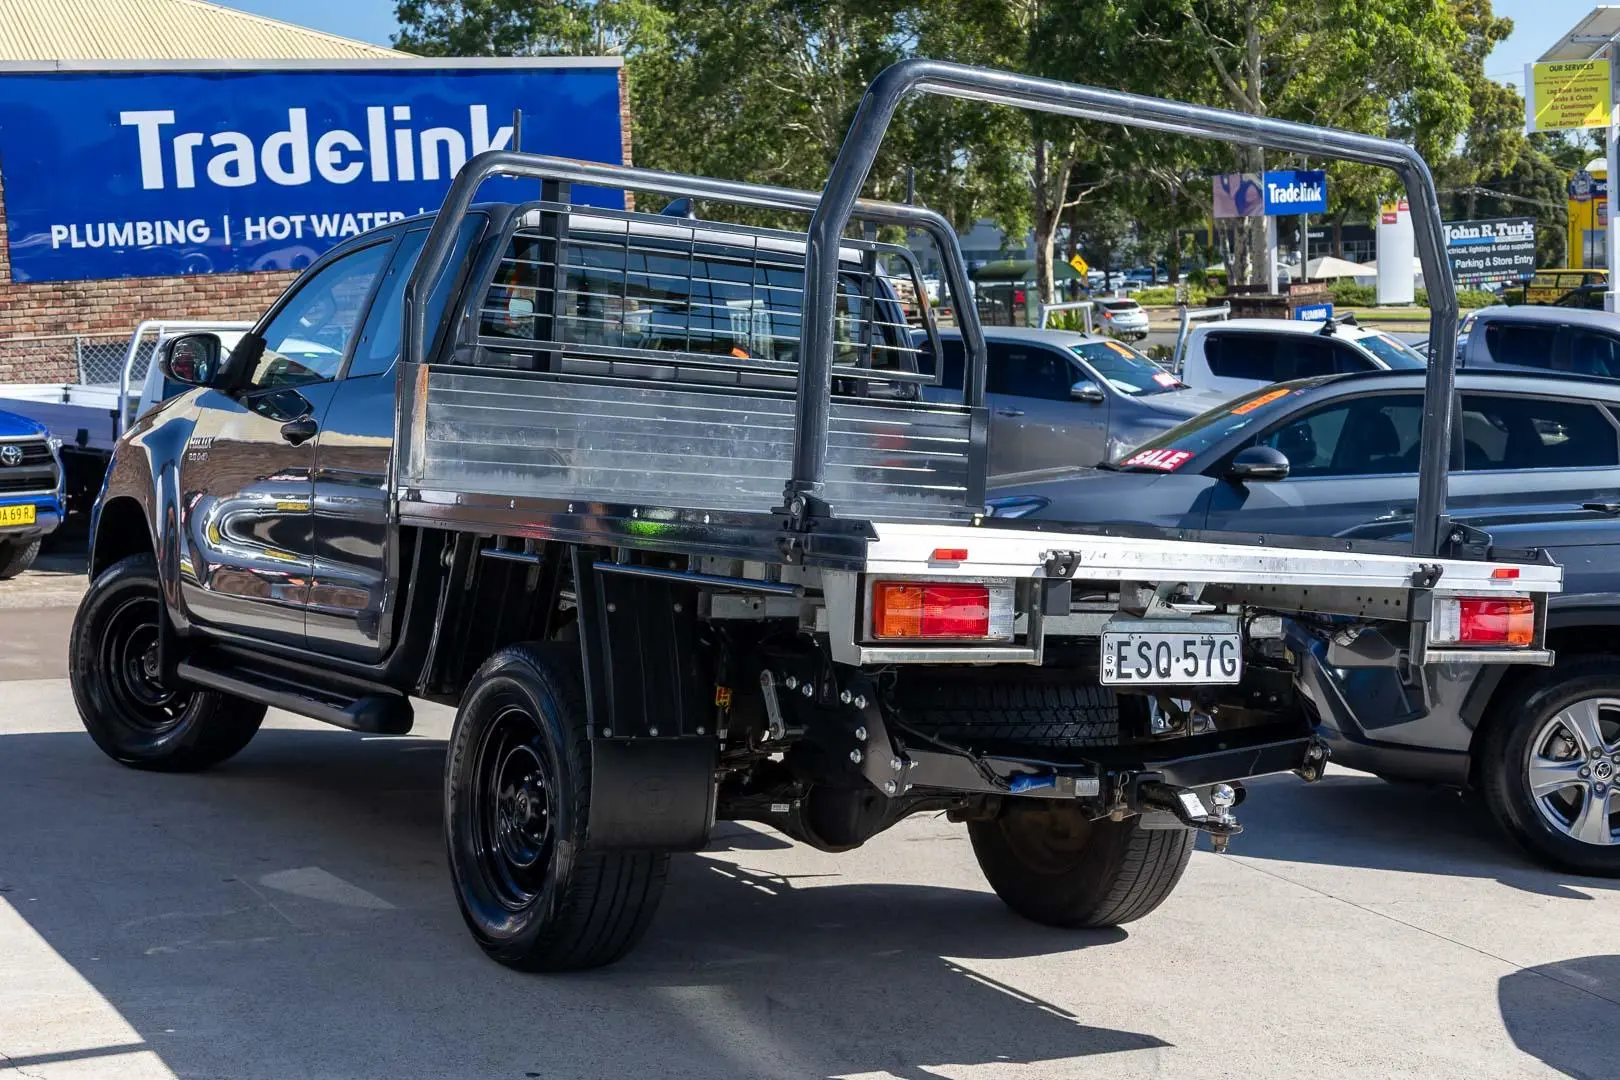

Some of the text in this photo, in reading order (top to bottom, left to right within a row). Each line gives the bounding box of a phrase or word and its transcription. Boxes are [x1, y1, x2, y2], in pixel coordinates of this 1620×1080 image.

[1564, 63, 1594, 71] SERVICES
[120, 104, 518, 189] Tradelink
[1267, 182, 1322, 203] Tradelink
[51, 218, 210, 249] PLUMBING
[245, 215, 305, 241] HOT
[1443, 225, 1480, 246] John
[1480, 224, 1496, 237] R.
[1496, 221, 1534, 236] Turk
[1469, 245, 1491, 253] lighting
[1455, 255, 1534, 269] Parking & Store Entry
[1127, 449, 1190, 470] SALE
